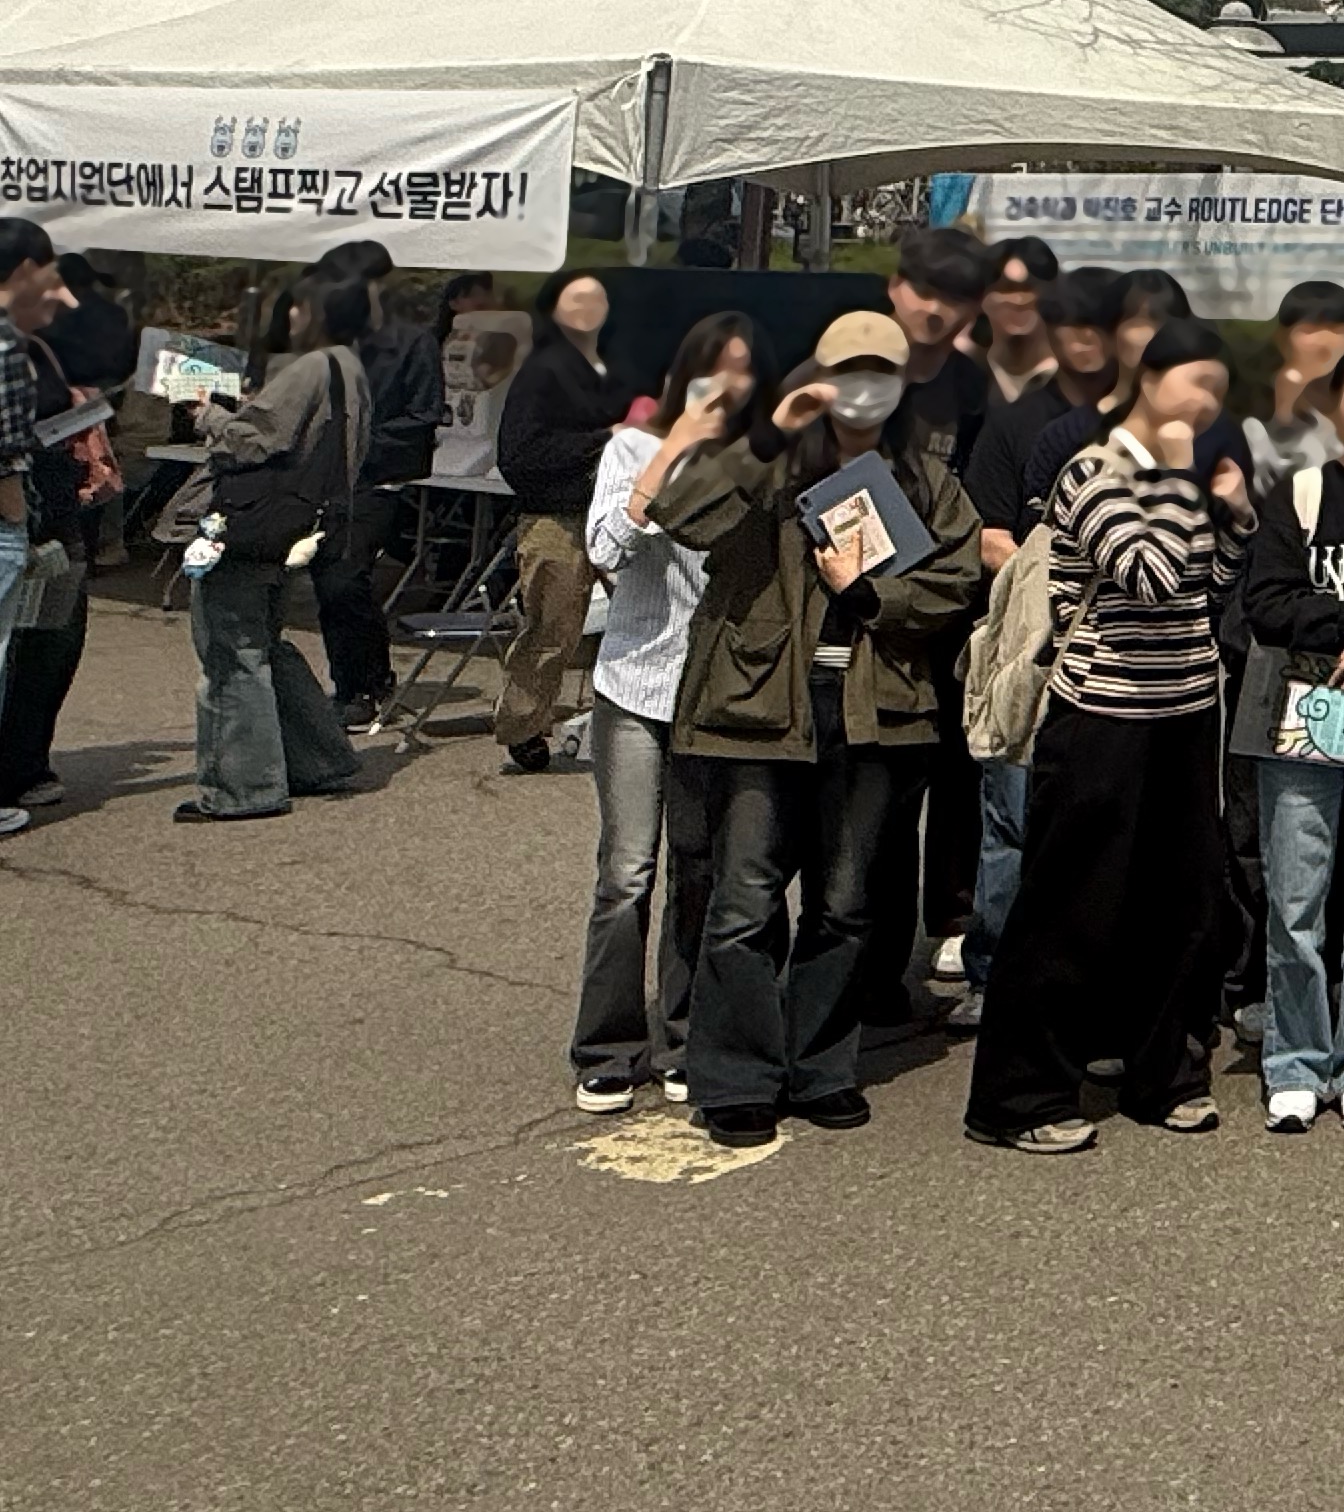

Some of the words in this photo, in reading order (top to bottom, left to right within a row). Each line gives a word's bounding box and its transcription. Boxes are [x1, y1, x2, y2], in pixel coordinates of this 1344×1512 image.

[0, 157, 193, 210] 창업지원단에서
[203, 165, 364, 216] 스탬프찍고
[369, 169, 529, 222] 선물받자!
[1145, 197, 1182, 222] 교수
[1188, 197, 1314, 224] ROUTLEDGE
